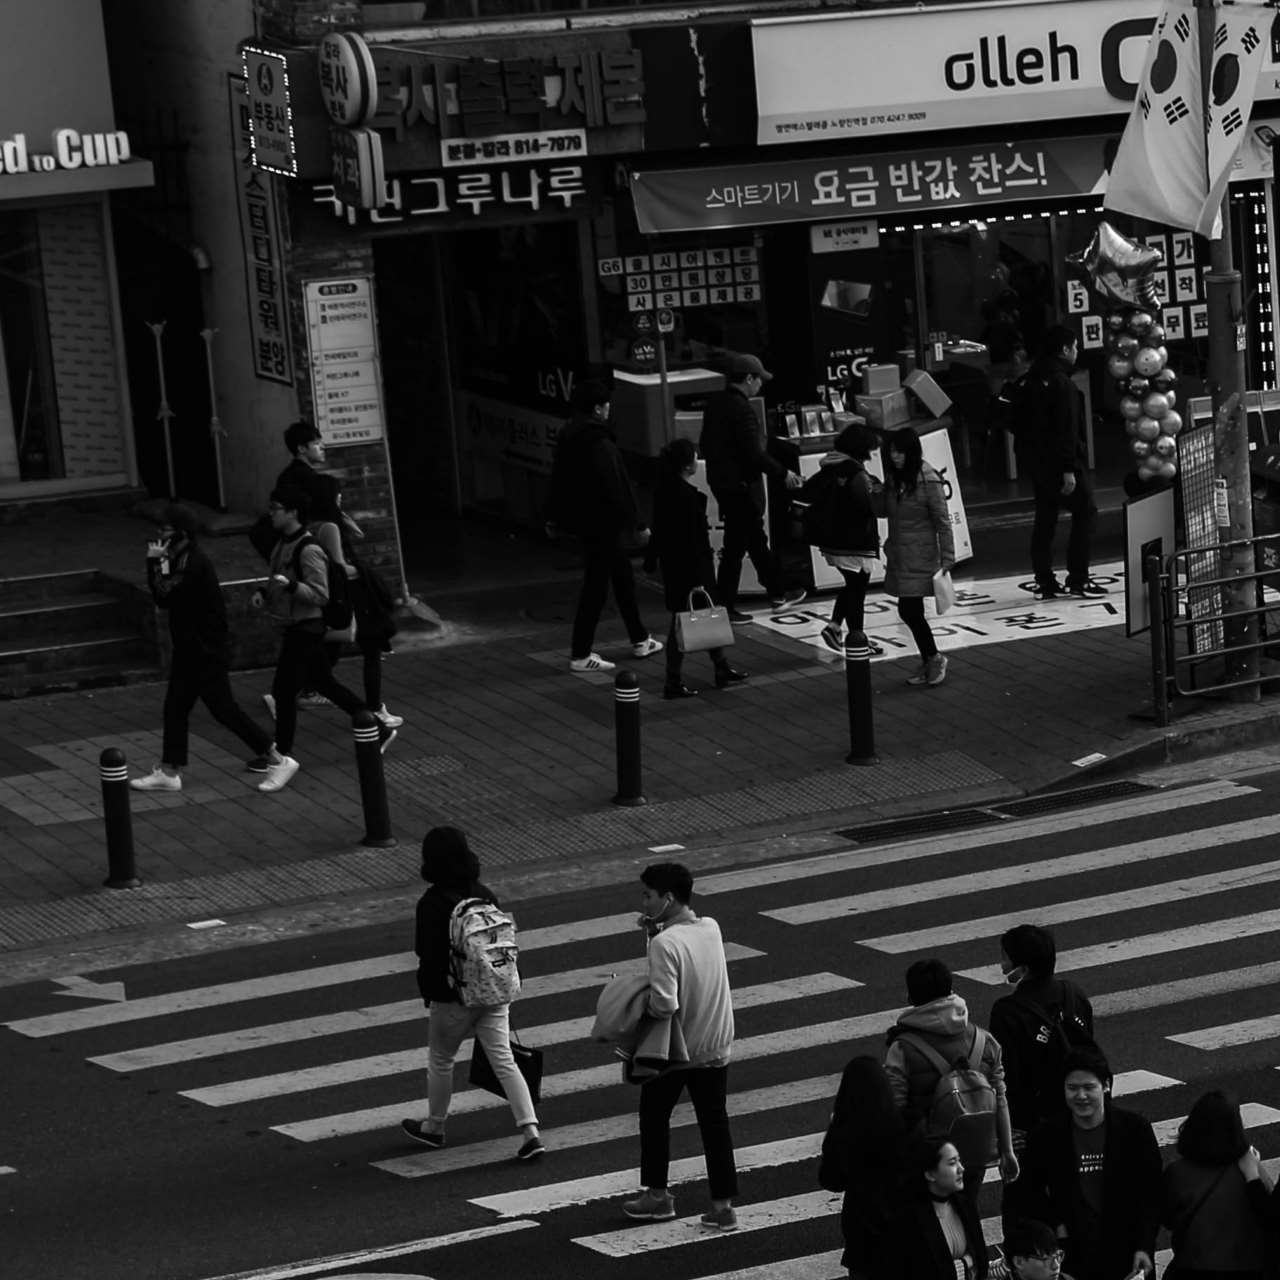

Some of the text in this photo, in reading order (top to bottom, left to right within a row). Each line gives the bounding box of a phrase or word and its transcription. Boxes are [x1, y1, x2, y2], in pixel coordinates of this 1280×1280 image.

[944, 30, 1080, 91] olleh
[321, 61, 348, 100] 복사
[254, 100, 287, 134] 부동산
[0, 133, 29, 174] d
[54, 127, 131, 170] Cup
[705, 152, 1048, 209] 스마트기기 요금 반값 찬스!
[601, 261, 620, 273] G6
[537, 369, 557, 398] LG
[827, 356, 880, 382] LG G
